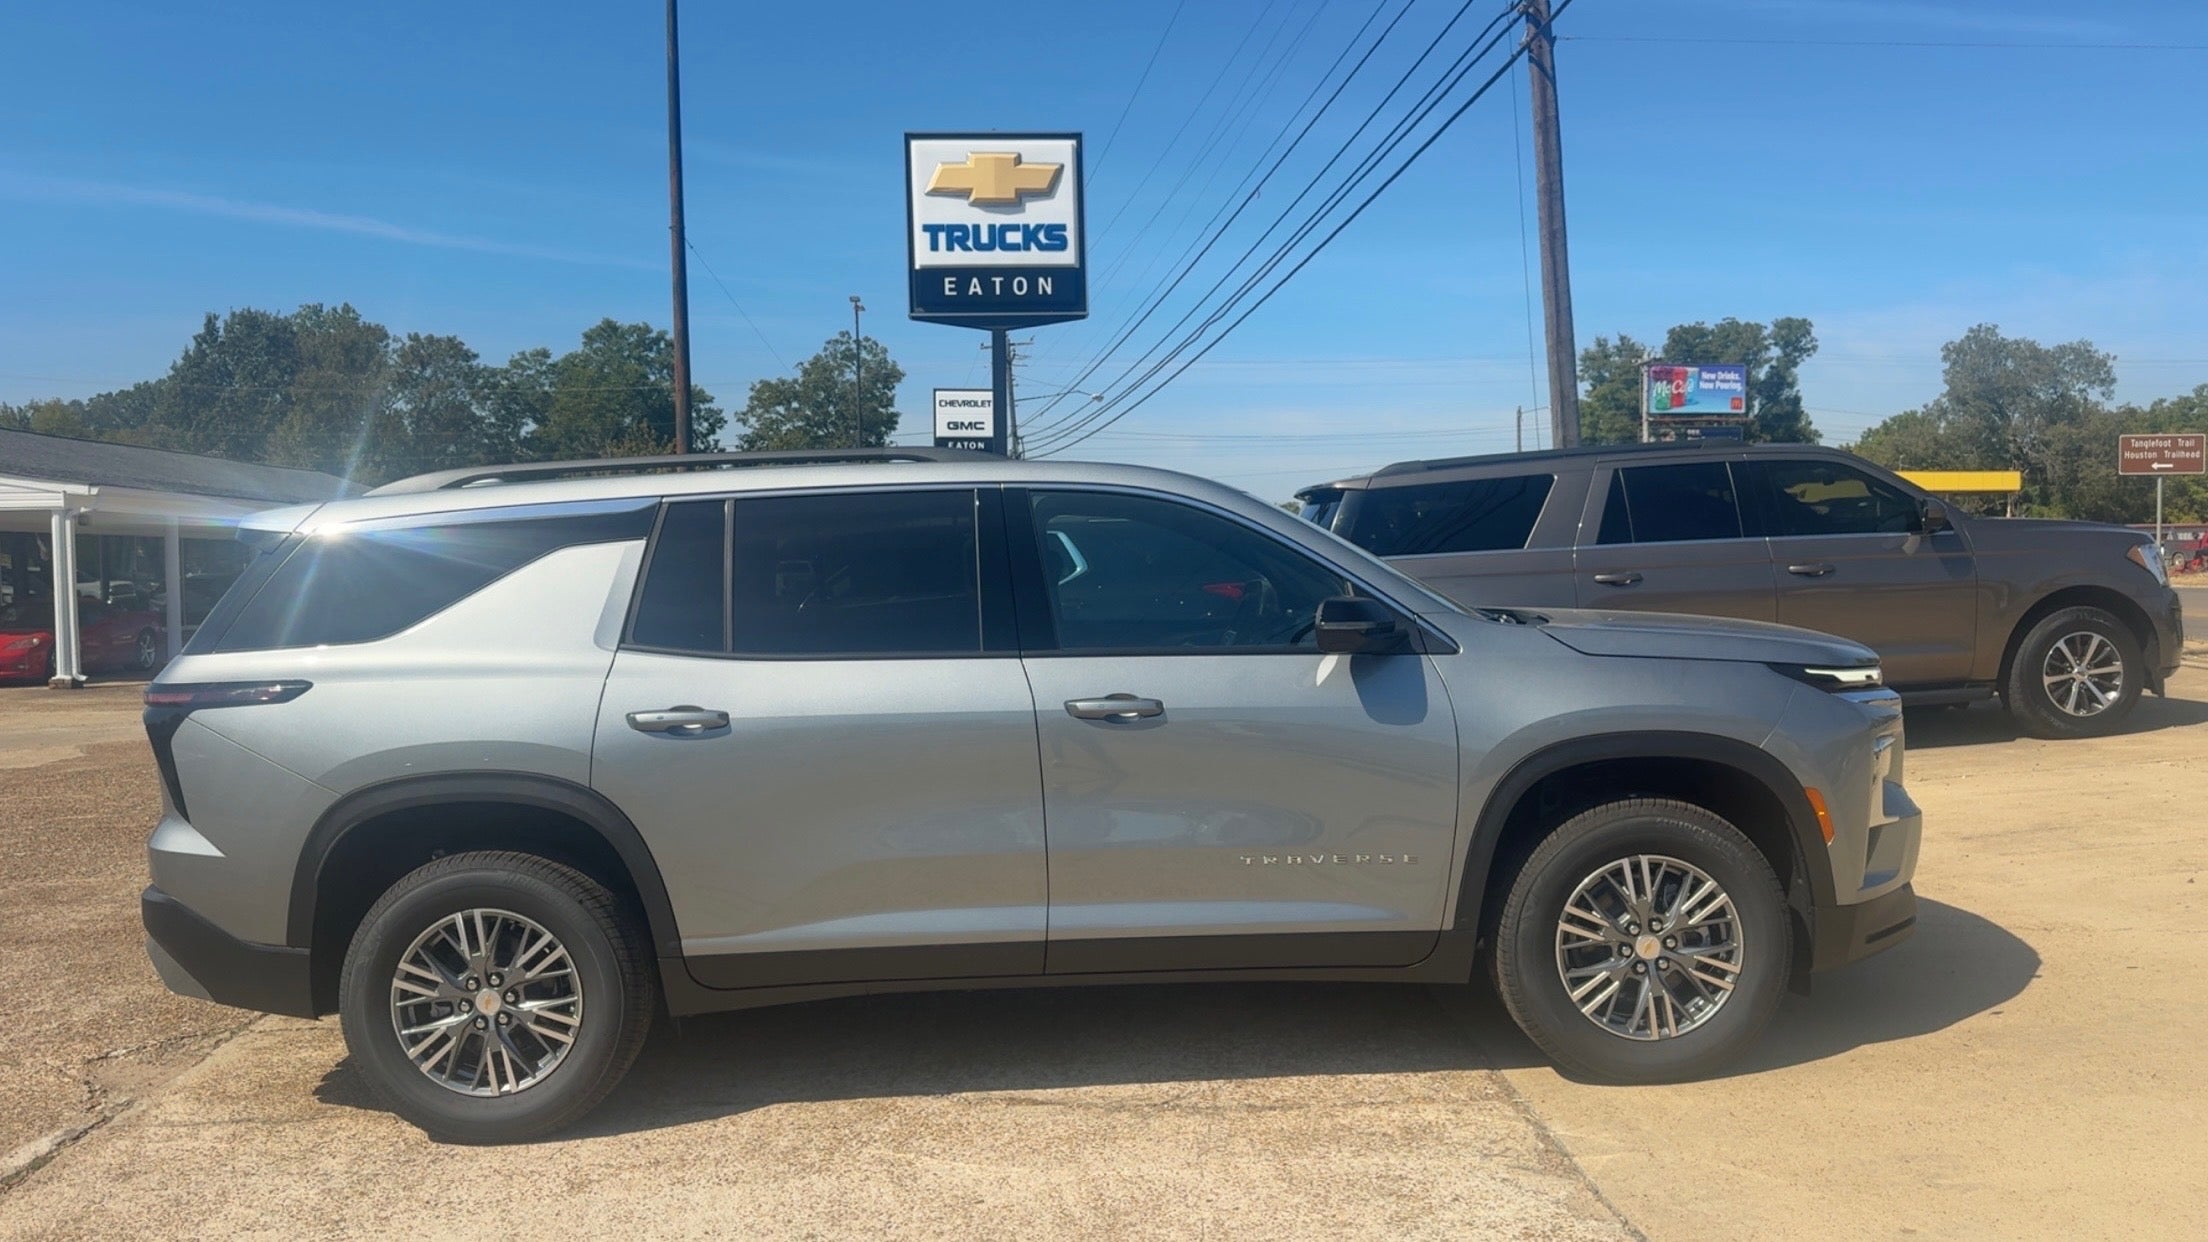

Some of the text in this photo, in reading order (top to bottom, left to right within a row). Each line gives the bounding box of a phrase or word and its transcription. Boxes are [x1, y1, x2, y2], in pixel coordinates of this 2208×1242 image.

[922, 223, 1068, 252] TRUCKS
[944, 276, 1053, 296] EATON
[938, 399, 992, 408] CHEVROLET
[947, 421, 985, 431] GMC
[2131, 438, 2195, 450] Tanglefoot Trail
[2124, 450, 2200, 459] Houston Trailhead
[1240, 853, 1419, 865] TRAVERSE
